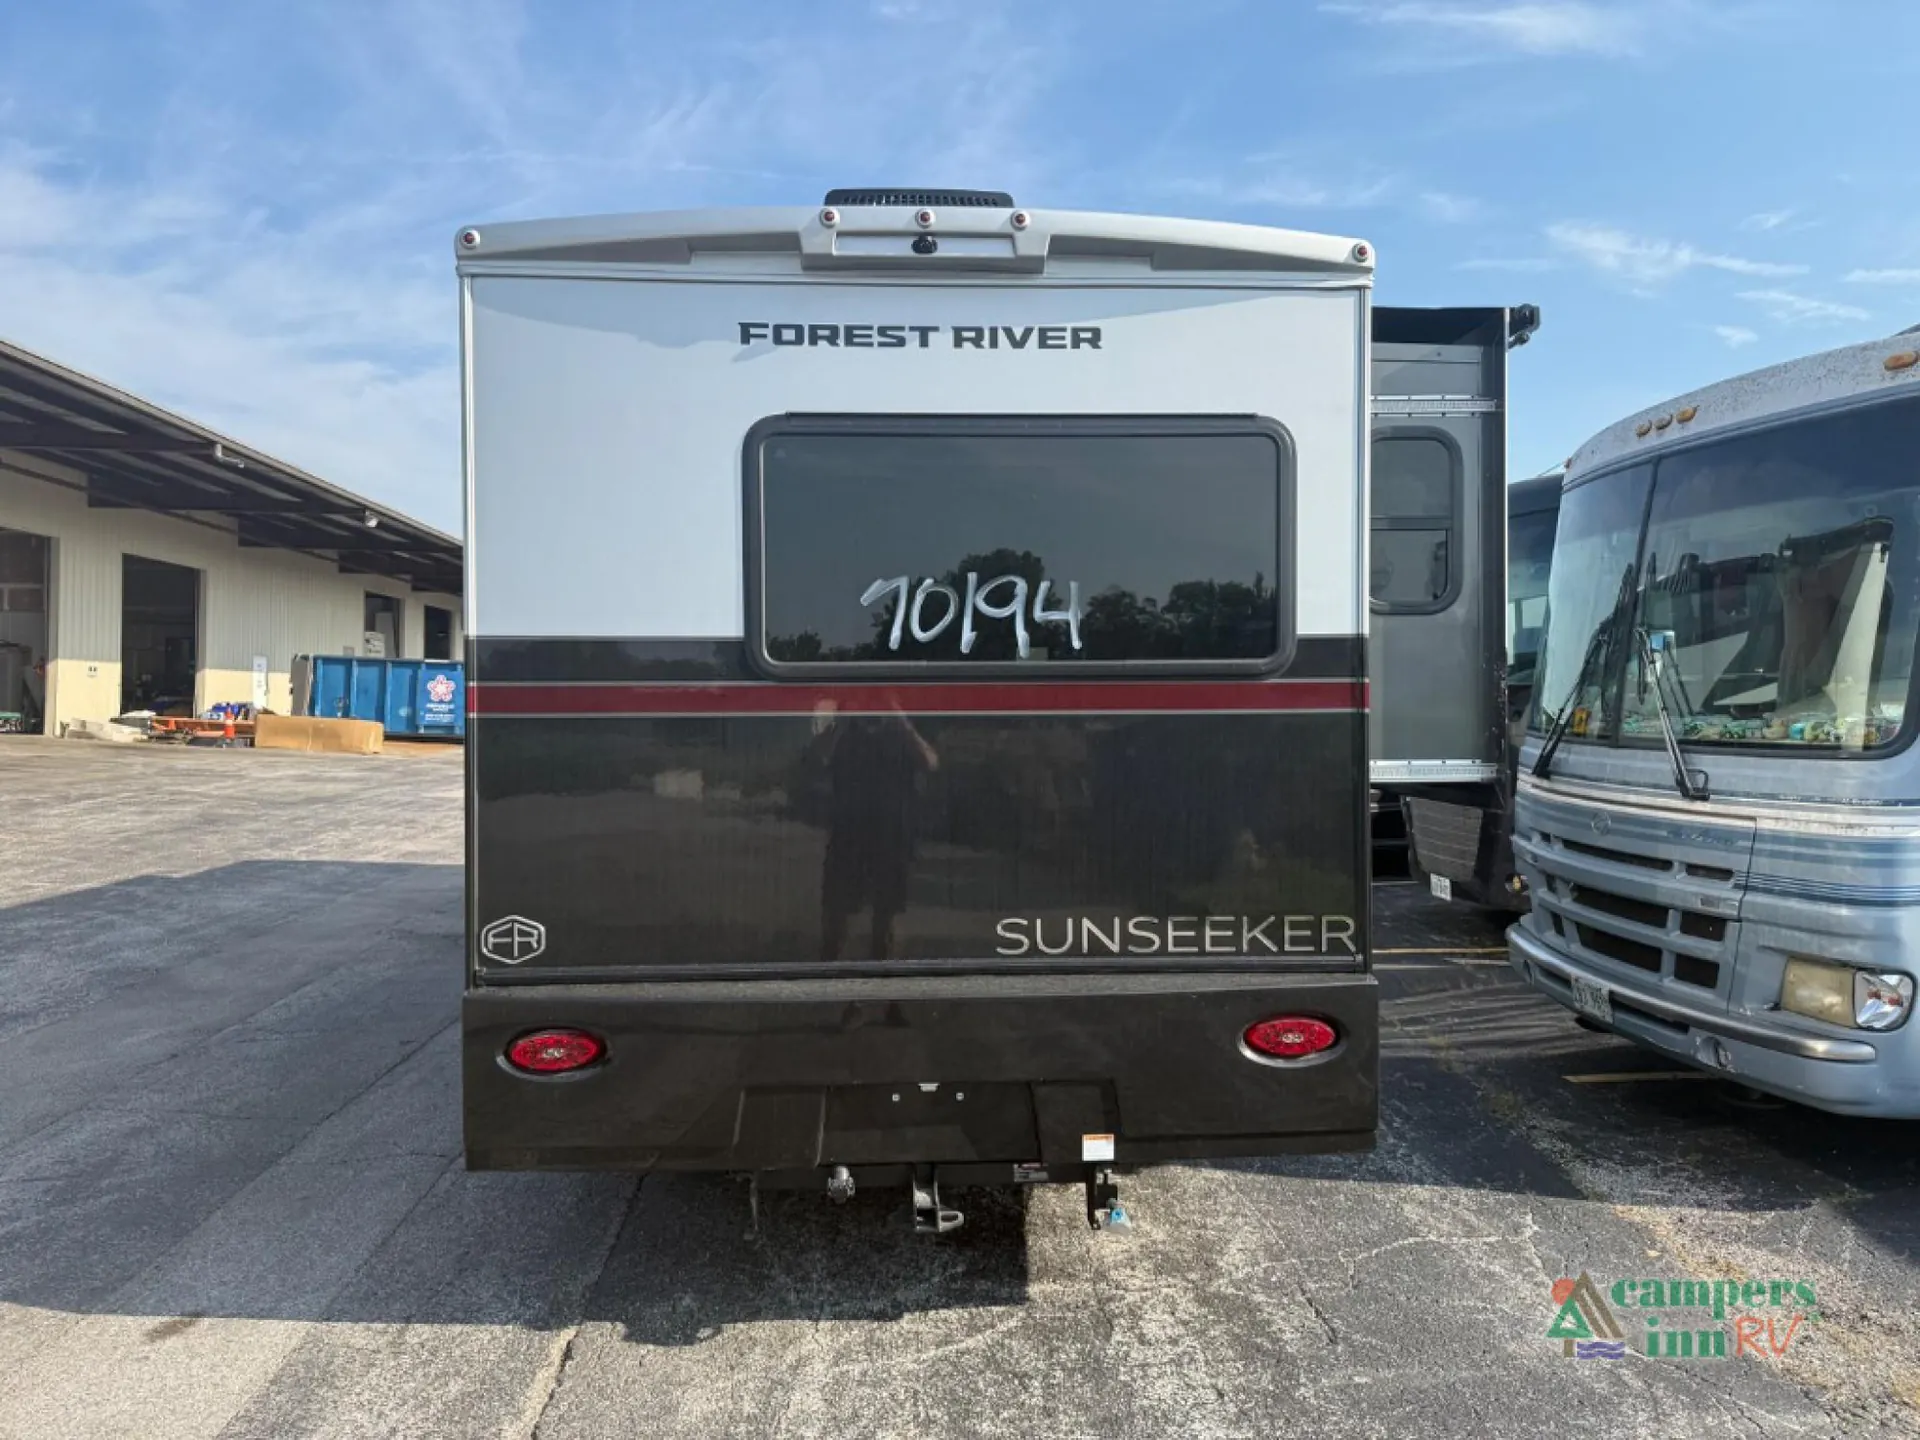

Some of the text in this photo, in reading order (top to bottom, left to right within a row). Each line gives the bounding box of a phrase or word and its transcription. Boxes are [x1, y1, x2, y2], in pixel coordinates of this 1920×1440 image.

[738, 321, 1103, 350] FOREST RIVER
[860, 571, 1082, 658] 70194
[995, 914, 1358, 956] SUNSEEKER
